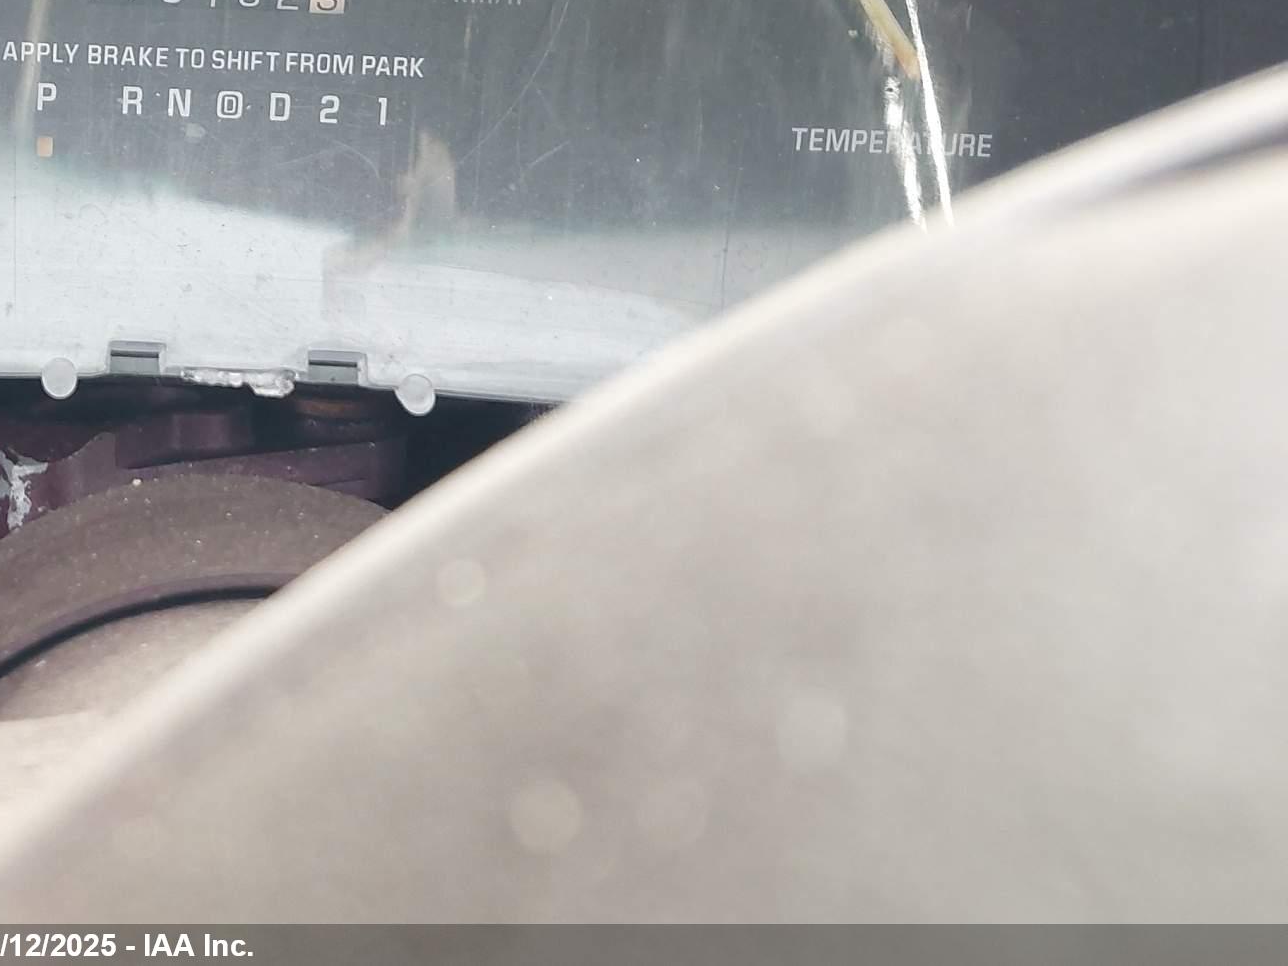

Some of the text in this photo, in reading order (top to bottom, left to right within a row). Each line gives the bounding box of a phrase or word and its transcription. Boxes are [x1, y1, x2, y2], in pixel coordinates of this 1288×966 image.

[2, 41, 425, 78] APPLY BRAKE TO SHIFT FROM PARK
[37, 82, 57, 110] P
[123, 86, 143, 114] R
[167, 89, 191, 117] N
[269, 92, 290, 121] D
[319, 95, 340, 123] 2
[378, 97, 388, 125] 1
